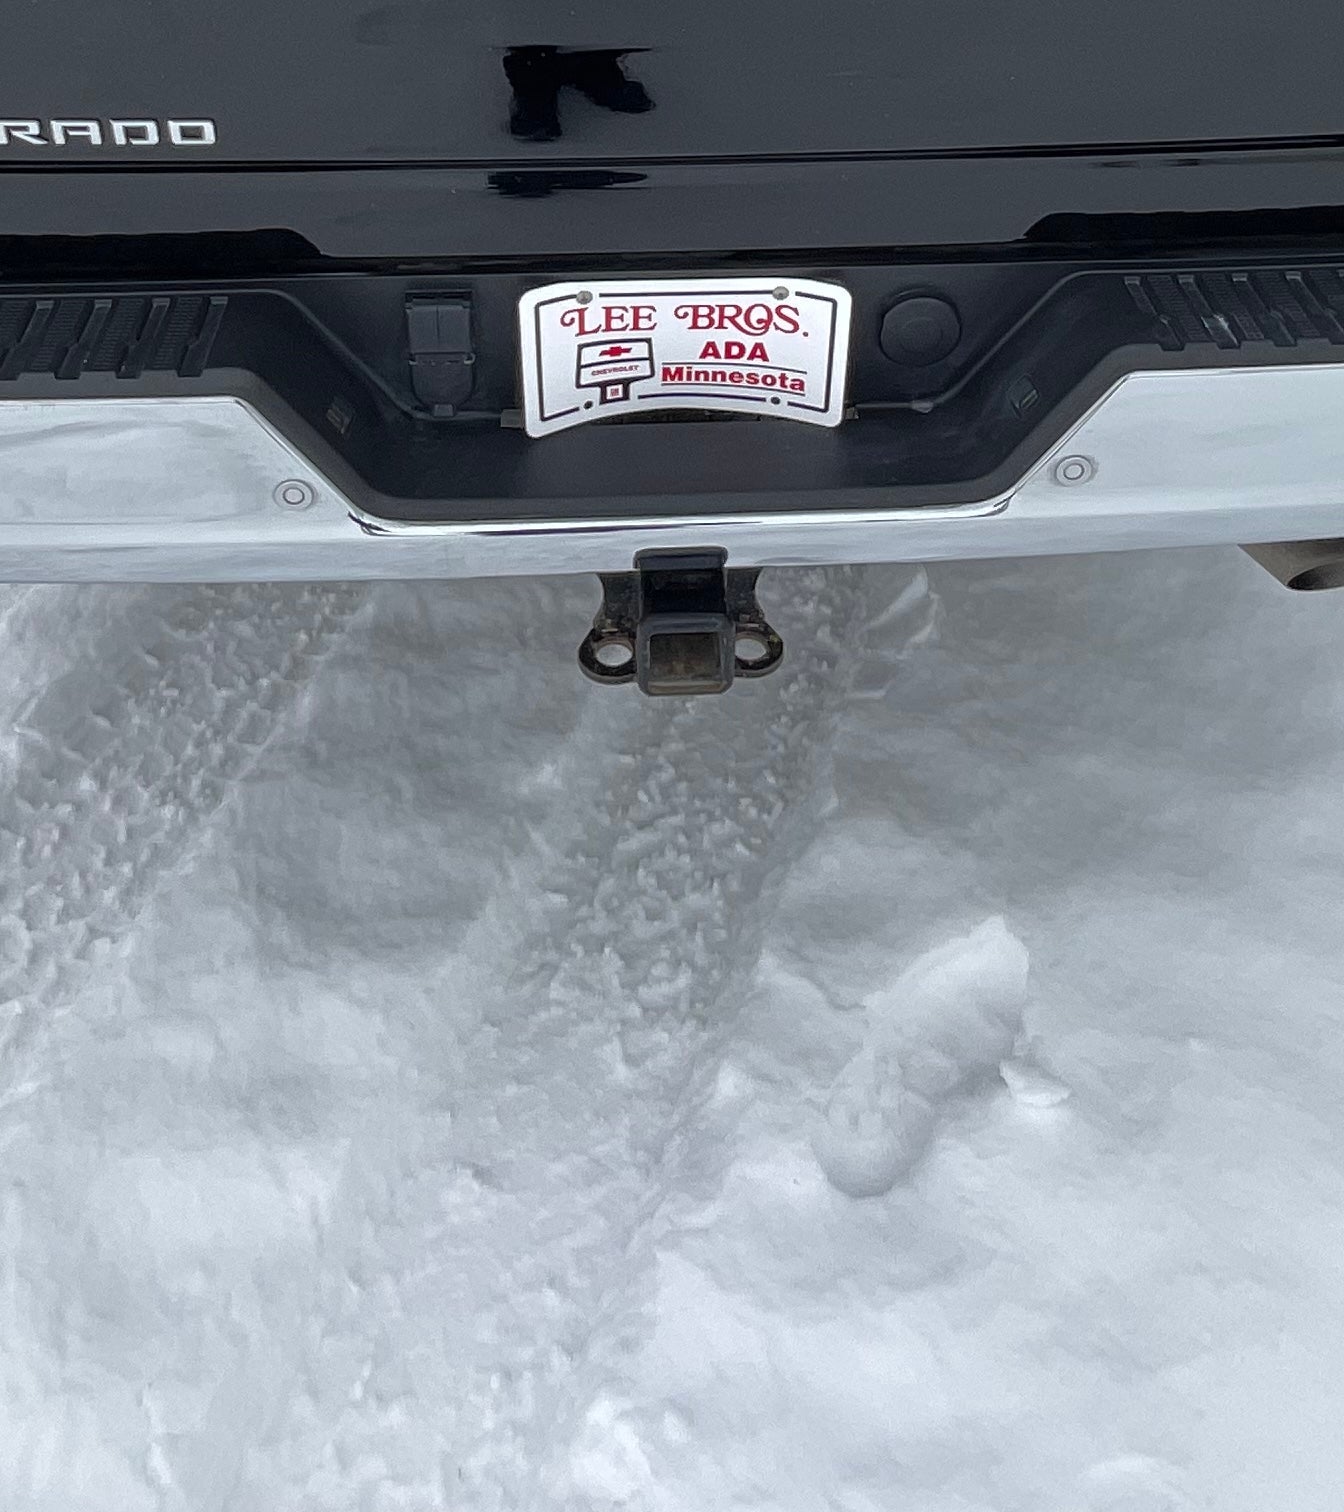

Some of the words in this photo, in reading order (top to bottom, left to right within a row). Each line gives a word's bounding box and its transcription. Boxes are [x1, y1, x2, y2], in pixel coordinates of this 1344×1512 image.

[560, 304, 658, 337] LEE
[674, 303, 808, 337] BROS.
[699, 340, 769, 363] ADA
[661, 366, 805, 392] Minnesota
